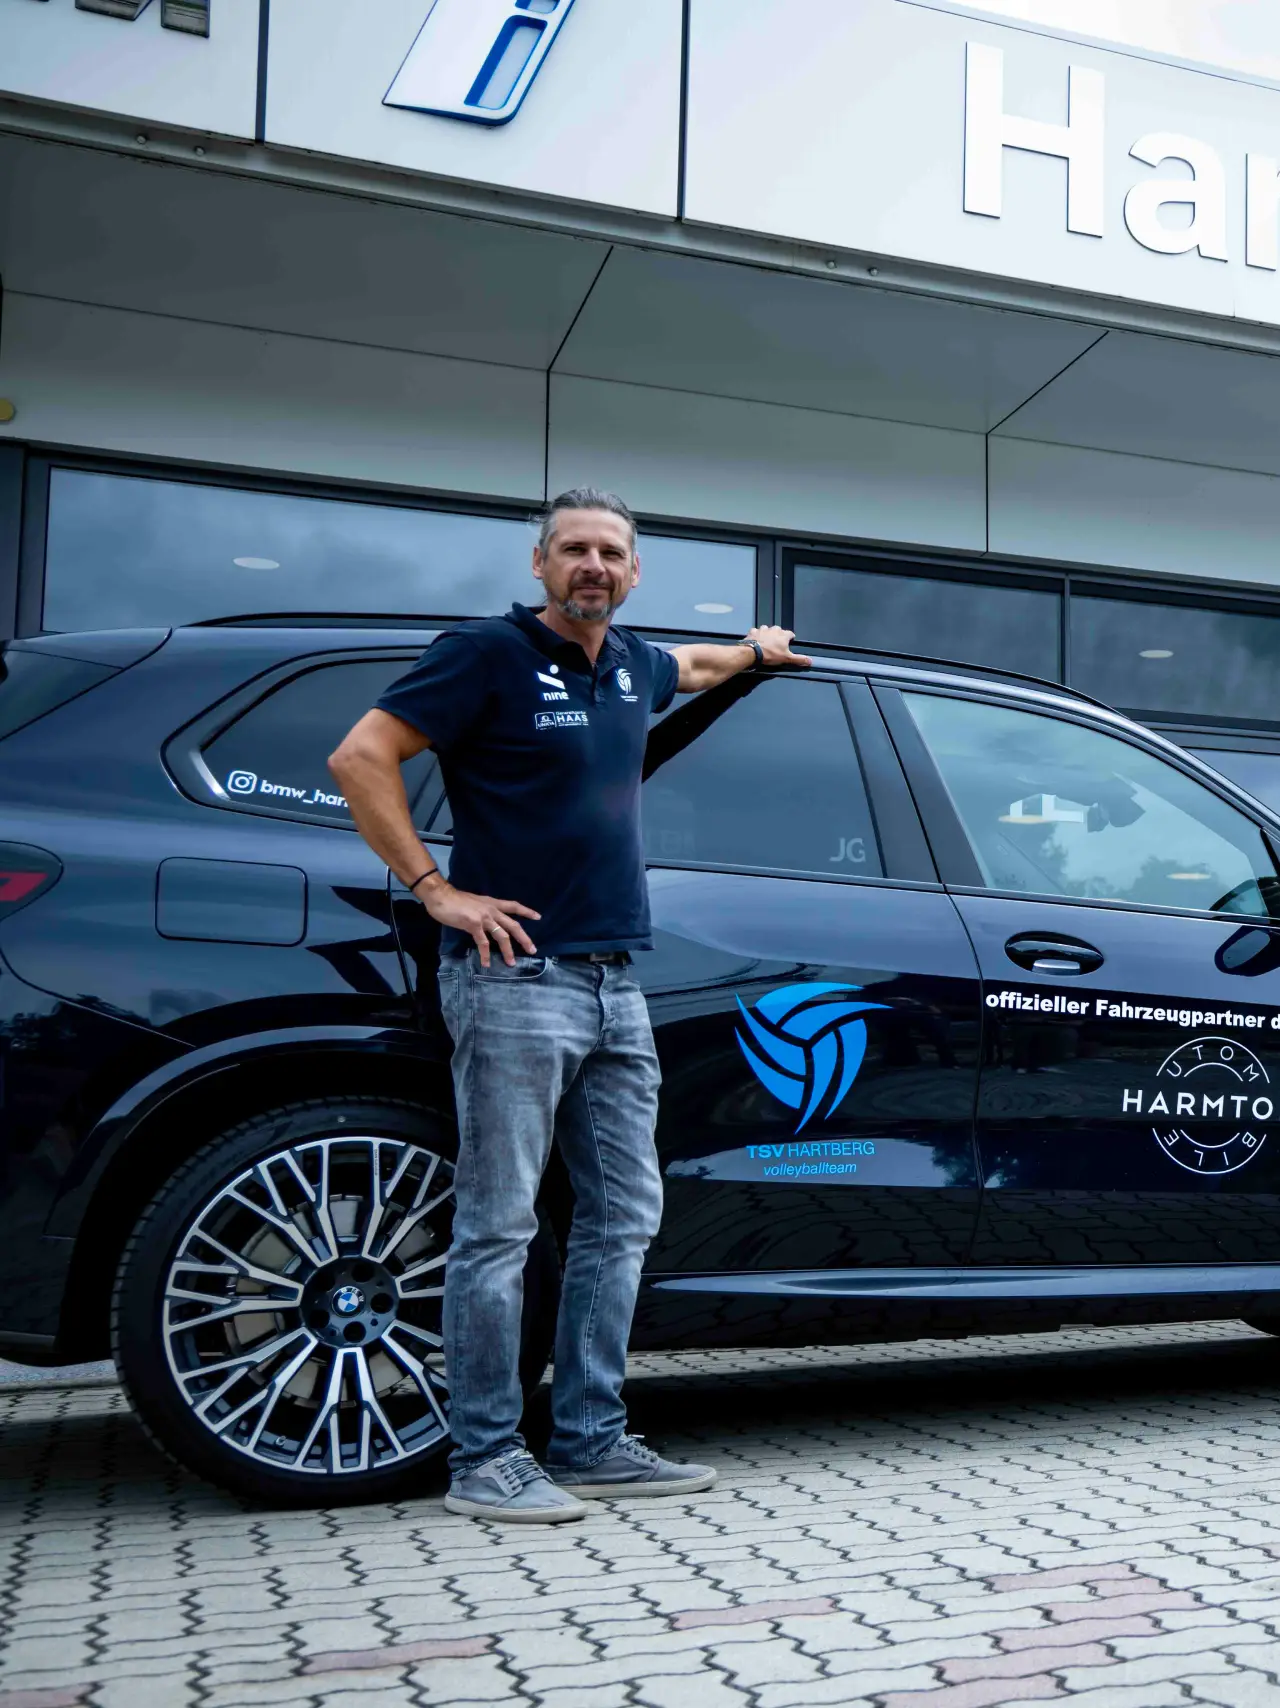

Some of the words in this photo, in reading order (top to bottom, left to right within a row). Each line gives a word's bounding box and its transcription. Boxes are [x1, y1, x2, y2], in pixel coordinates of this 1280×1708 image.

[543, 691, 569, 701] nine
[556, 714, 588, 723] HAAS
[829, 837, 867, 863] JG
[985, 991, 1089, 1015] offizieller
[1095, 999, 1266, 1028] Fahrzeugpartner
[746, 1144, 785, 1159] TSV
[788, 1141, 876, 1158] HARTBERG
[763, 1162, 857, 1179] volleyballteam
